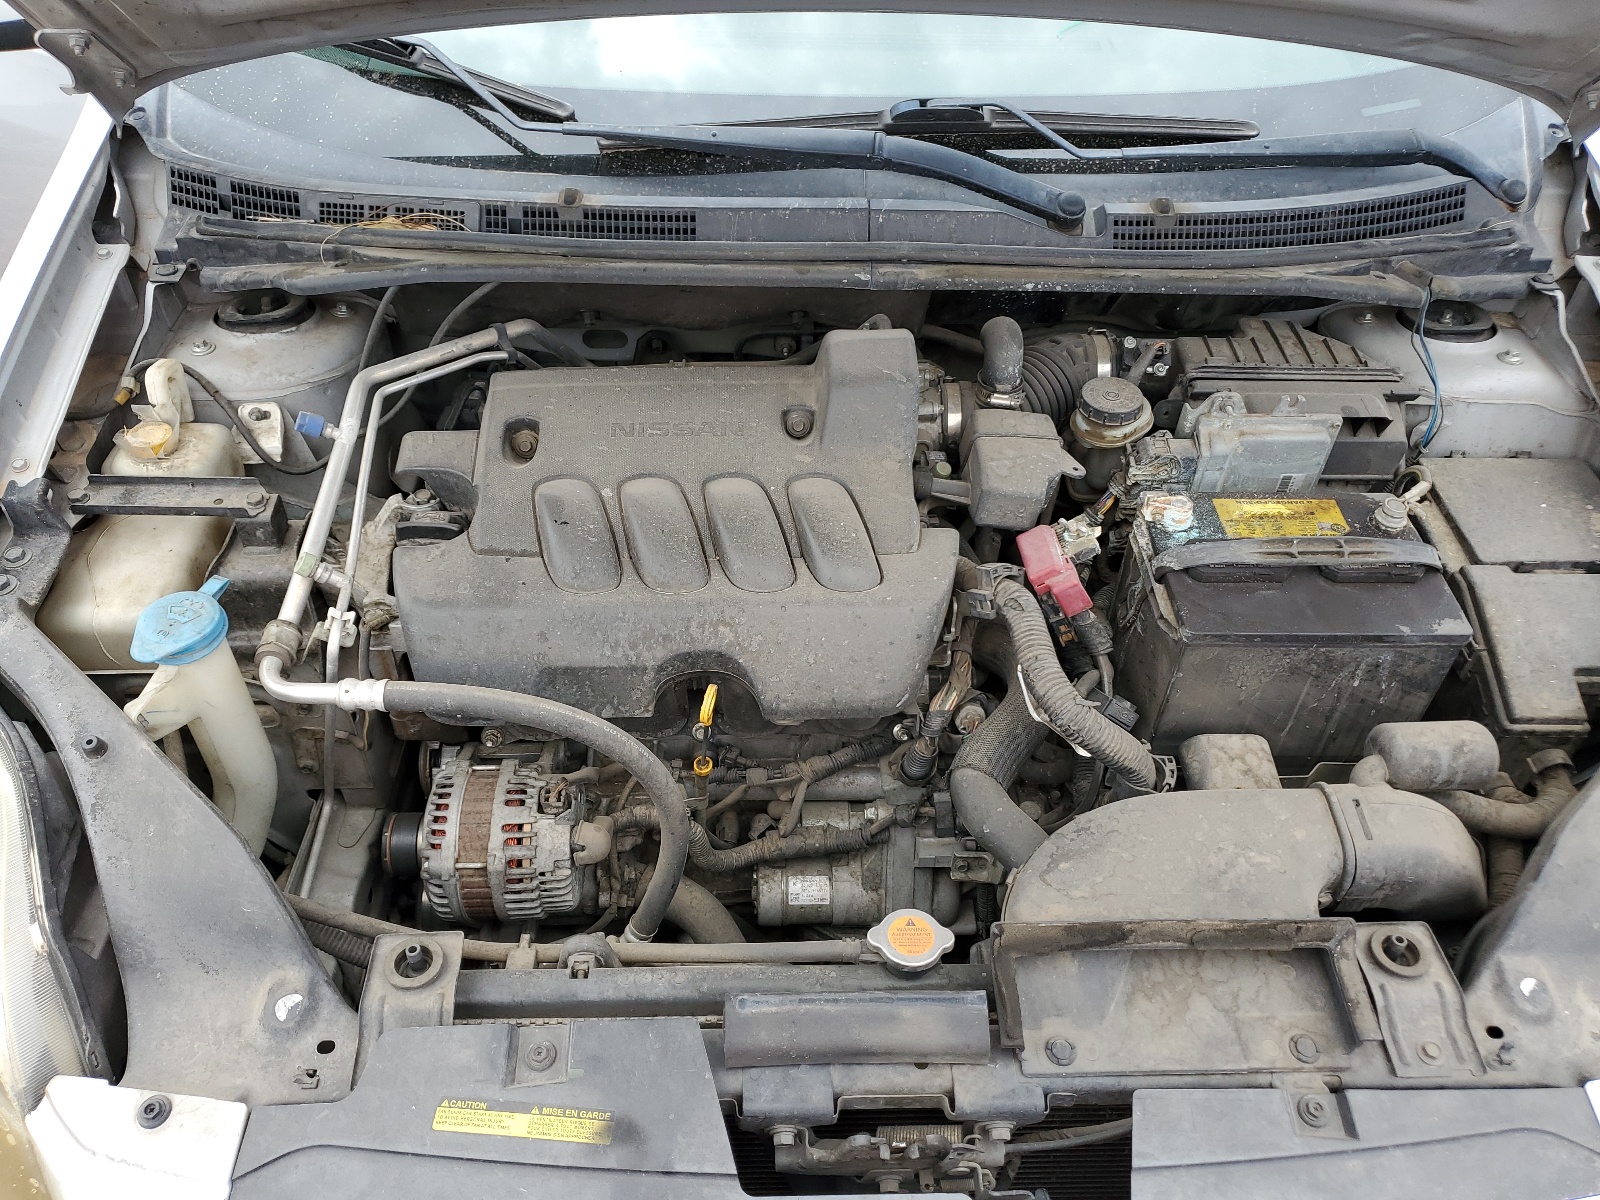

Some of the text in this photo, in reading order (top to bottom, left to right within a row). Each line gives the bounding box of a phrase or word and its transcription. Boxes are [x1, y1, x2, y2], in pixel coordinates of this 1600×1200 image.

[609, 421, 744, 438] NISSAN
[450, 1100, 487, 1110] CAUTION
[542, 1107, 612, 1120] MISE EN GARDE
